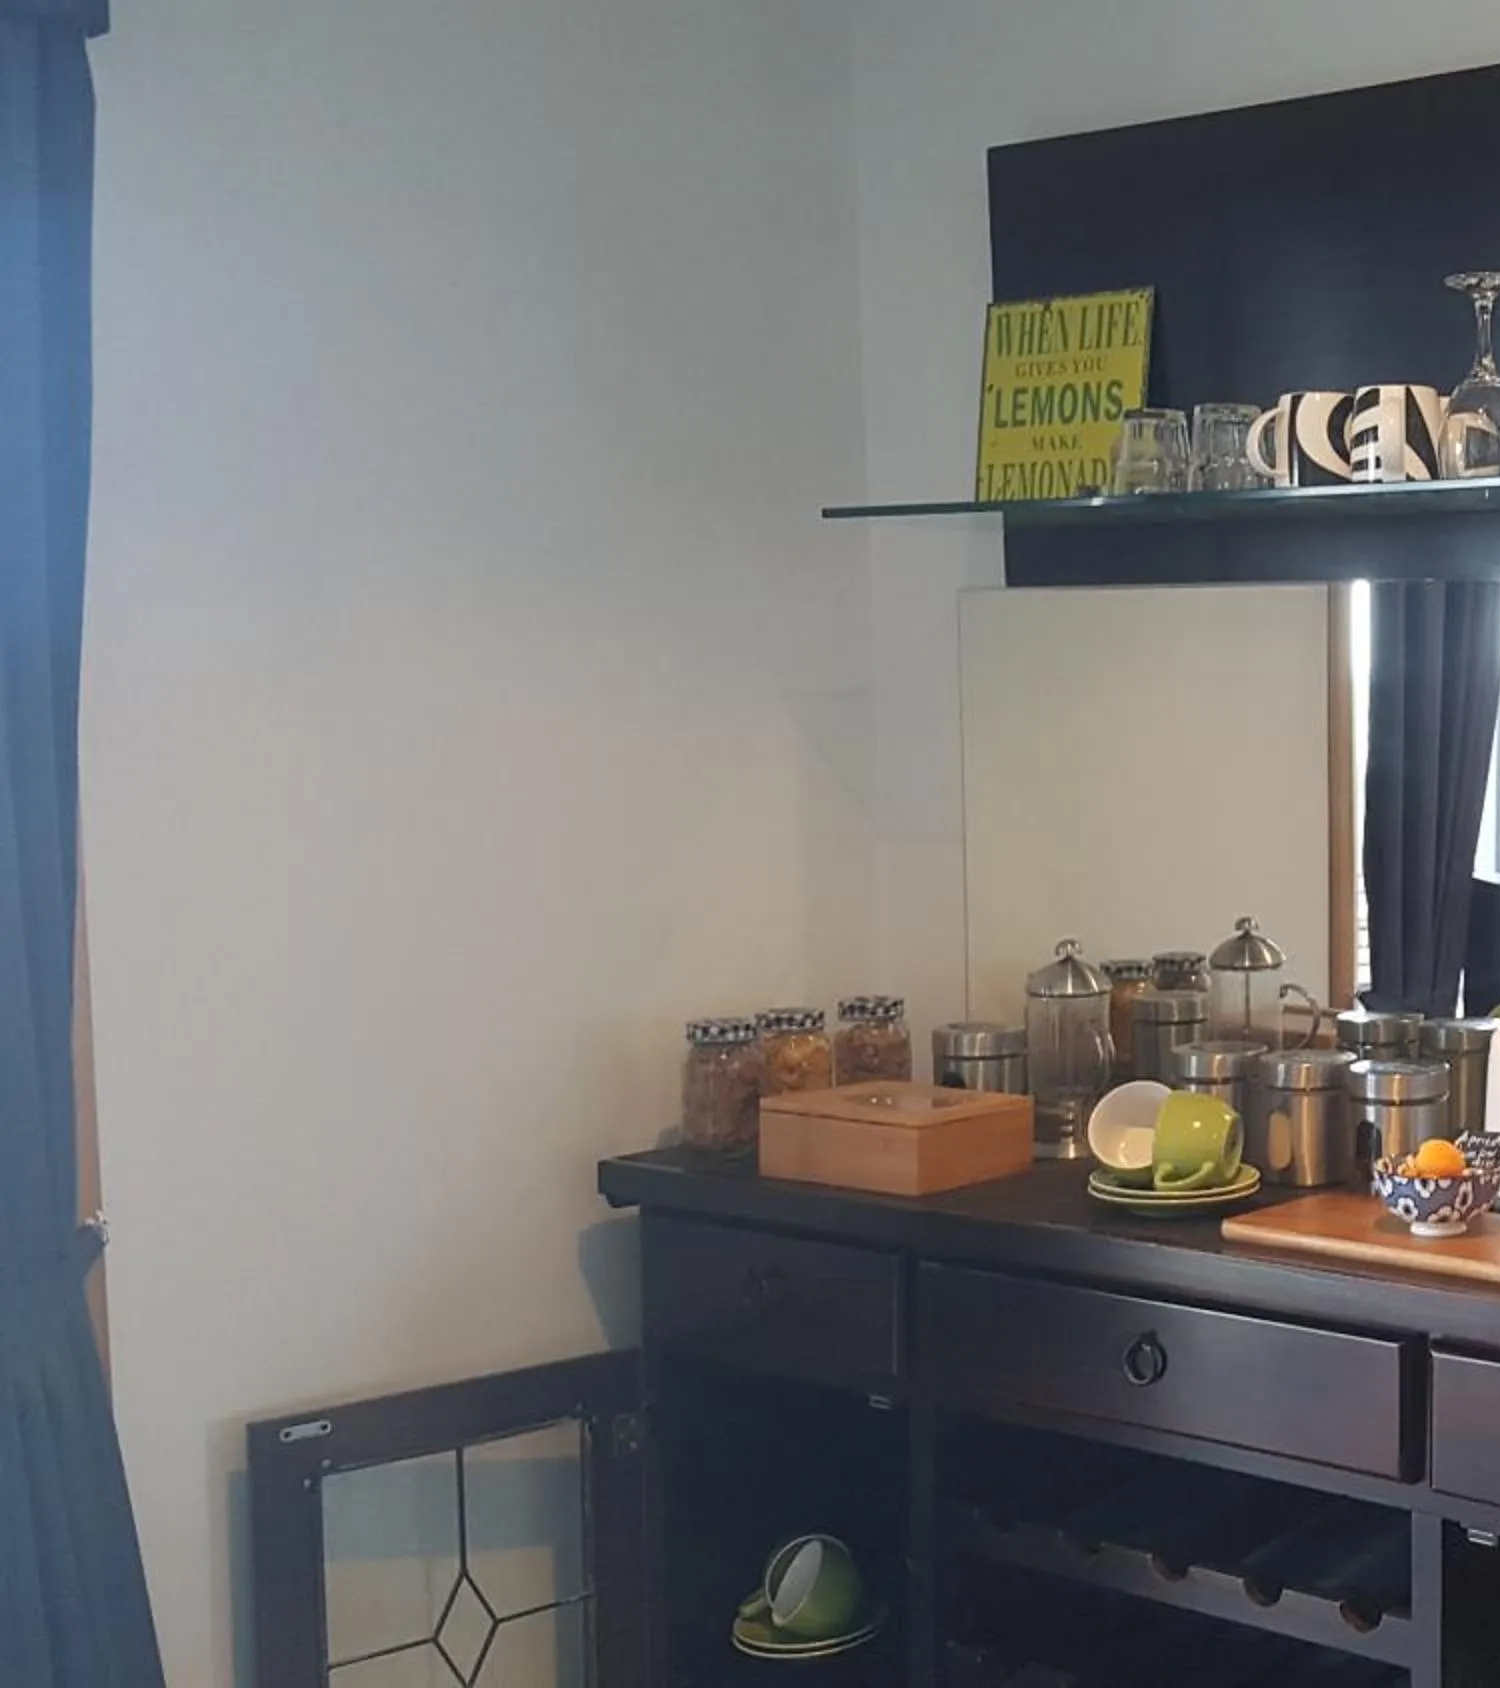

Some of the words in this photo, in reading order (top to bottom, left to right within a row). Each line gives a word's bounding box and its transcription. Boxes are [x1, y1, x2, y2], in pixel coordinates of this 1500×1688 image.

[996, 306, 1070, 358] WHEN
[1079, 301, 1139, 351] LIFE
[1015, 361, 1067, 378] GIVES
[1073, 355, 1107, 374] YOU
[994, 379, 1123, 428] LEMONS
[1032, 435, 1082, 451] MAKE
[987, 456, 1115, 501] LEMONAD
